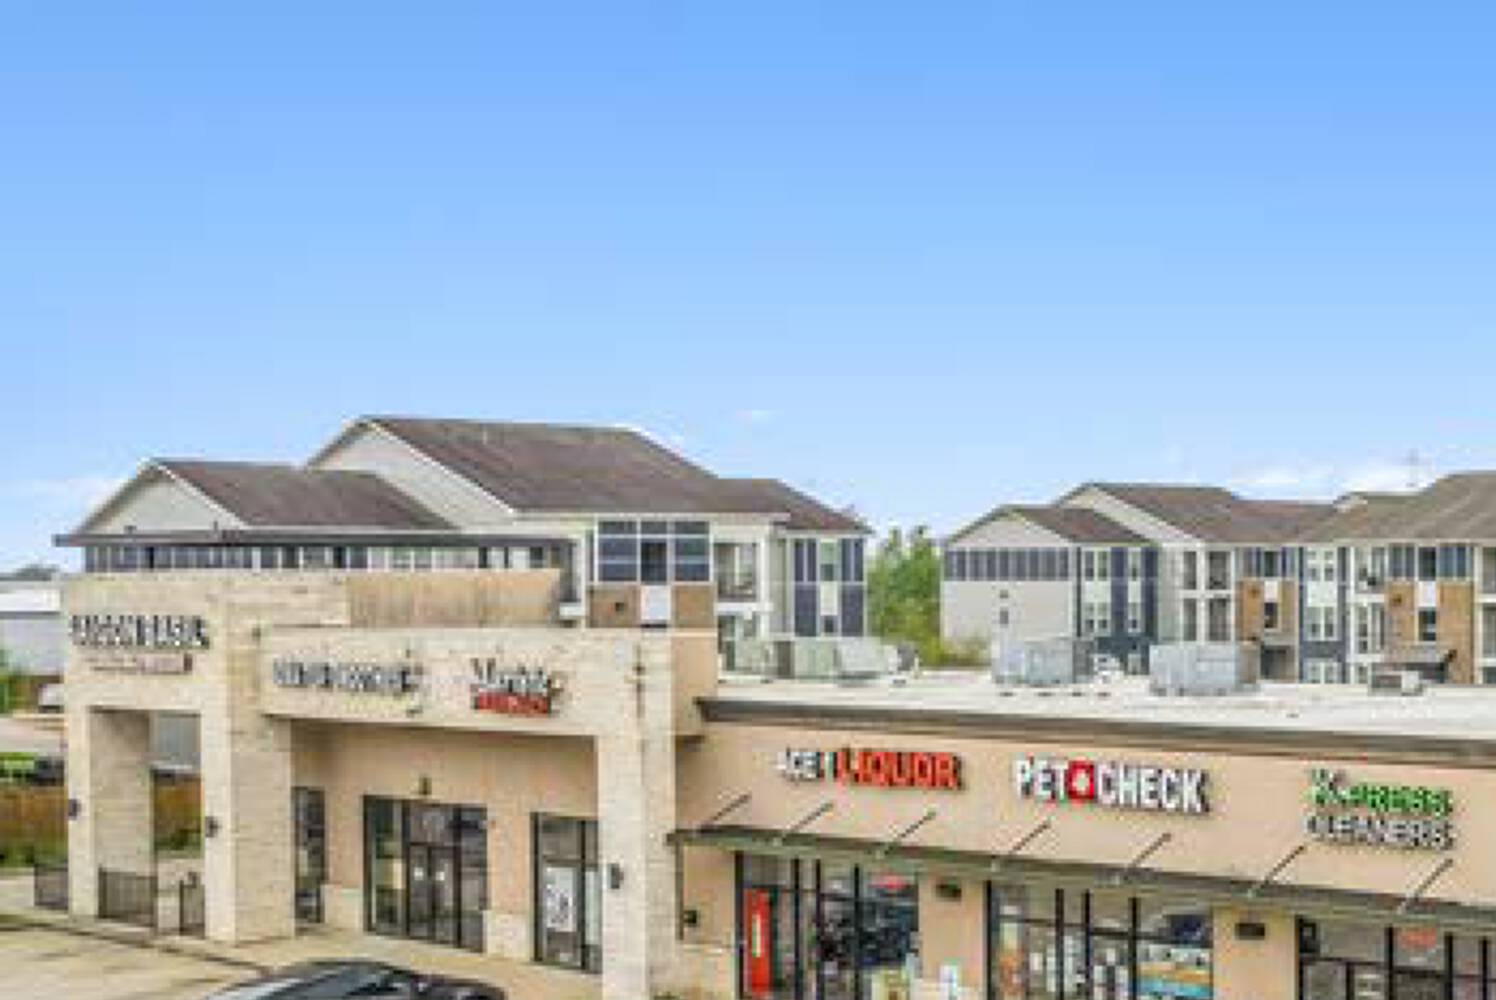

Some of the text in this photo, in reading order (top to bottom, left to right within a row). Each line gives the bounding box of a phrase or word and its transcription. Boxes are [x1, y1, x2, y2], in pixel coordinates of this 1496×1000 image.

[837, 750, 963, 791] LIQUOR
[1015, 758, 1209, 814] PET CHECK
